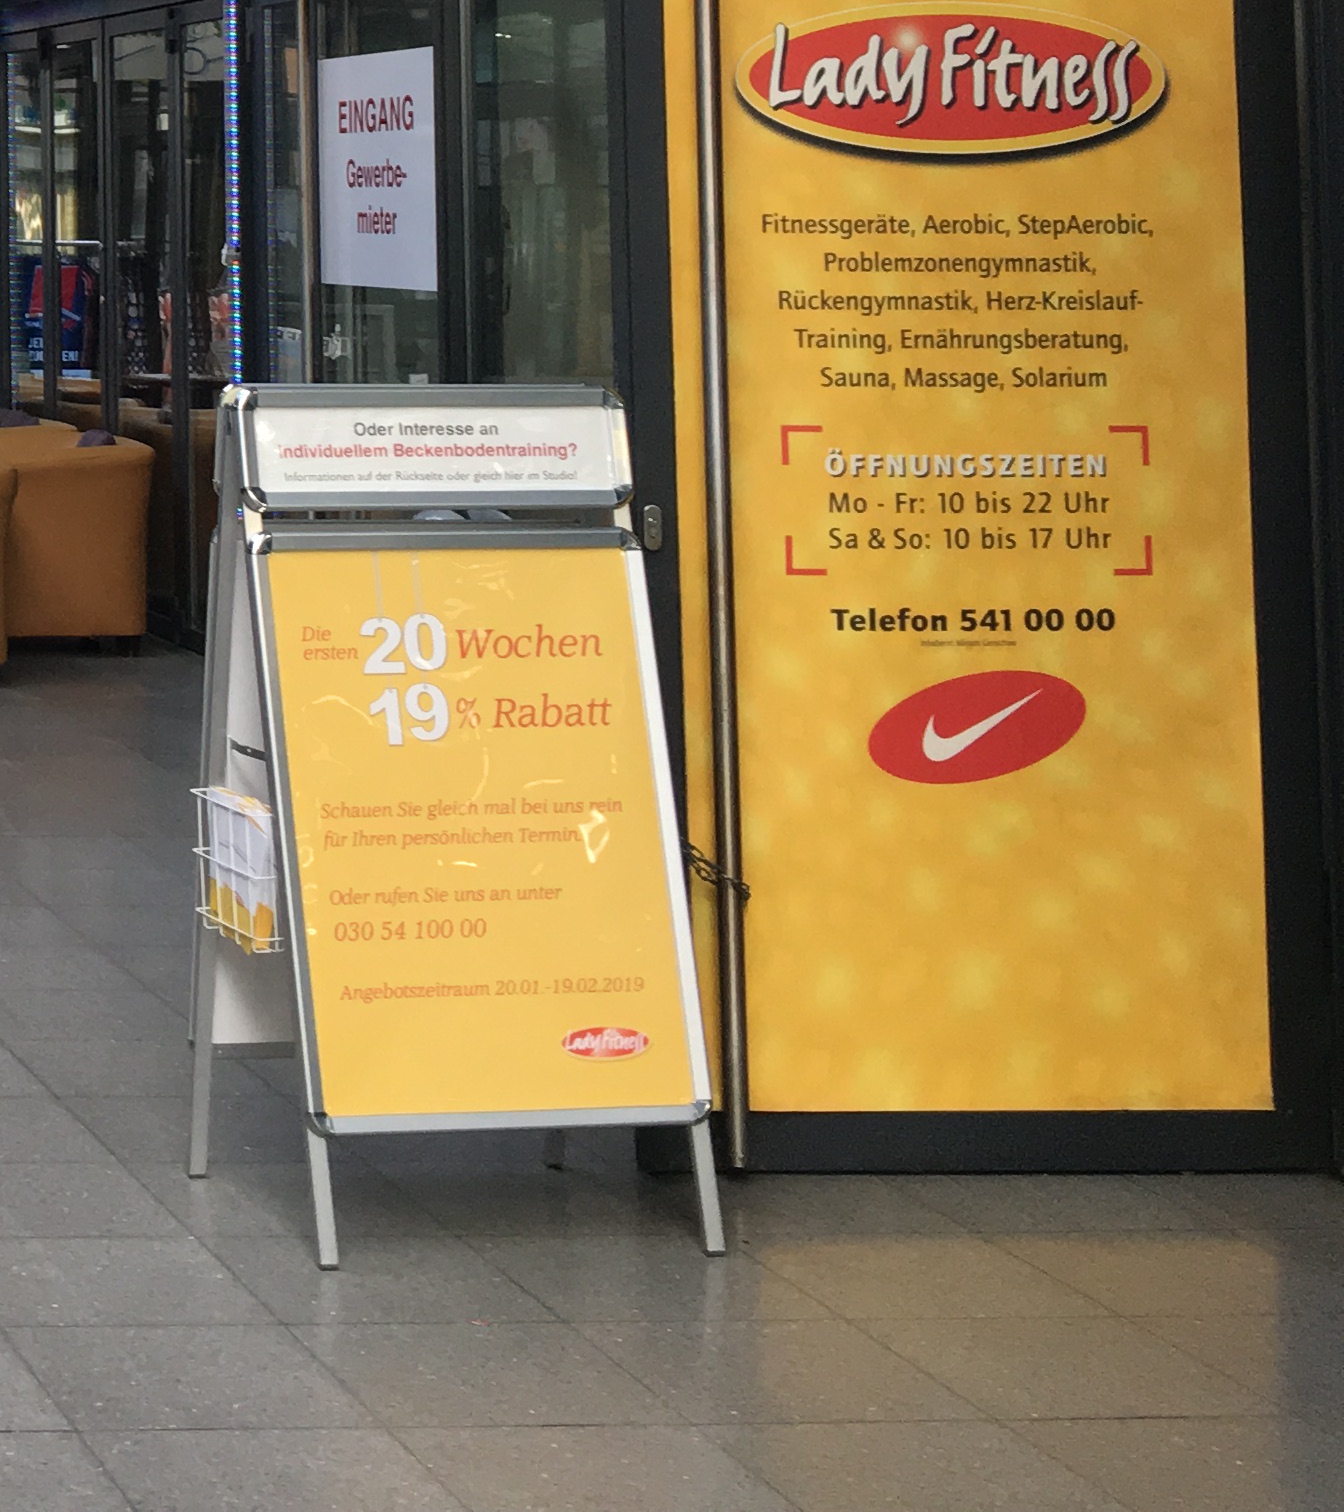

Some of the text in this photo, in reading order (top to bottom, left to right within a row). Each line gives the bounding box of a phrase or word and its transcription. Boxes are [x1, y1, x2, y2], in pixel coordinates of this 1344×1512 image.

[769, 22, 1140, 126] Lady Fitness
[338, 94, 414, 134] EINGANG
[345, 158, 407, 188] Gewerbe-
[356, 204, 397, 235] mieter
[761, 213, 1154, 239] Fitnessgeräte, Aerobic, StepAerobic,
[823, 252, 1097, 278] Problemzonengymnastik,
[778, 290, 1143, 316] Rückengymnastik, Herz-Kreislauf-
[794, 329, 1129, 354] Training, Ernährungsberatung,
[820, 367, 1108, 393] Sauna, Massage, Solarium
[353, 423, 499, 436] Oder Interesse an
[278, 442, 578, 460] individuellem Beckenbodentraining?
[824, 448, 1108, 477] ÖFFNUNGSZEITEN
[284, 472, 355, 483] Informationen
[358, 471, 373, 481] auf
[375, 471, 392, 481] der
[395, 471, 443, 481] Rückseite
[446, 471, 470, 481] oder
[473, 471, 502, 483] gleich
[504, 471, 524, 480] hier
[828, 492, 868, 513] Mo
[895, 492, 925, 513] Fr:
[938, 492, 964, 513] 10
[975, 491, 1012, 513] bis
[1022, 492, 1052, 513] 22
[1064, 491, 1110, 513] Uhr
[828, 527, 1112, 549] Sa & So: 10 bis 17 Uhr
[830, 608, 1116, 632] Telefon 541 00 00
[302, 626, 332, 642] Die
[303, 613, 603, 675] ersten 20 Wochen
[369, 683, 612, 746] 19 % Rabatt
[321, 797, 623, 820] Schauen Sie gleich mal bei uns rein
[323, 830, 348, 851] für
[352, 830, 397, 847] Ihren
[401, 828, 513, 850] persönlichen
[329, 886, 562, 907] Oder rufen Sie uns an unter
[334, 918, 487, 942] 030 54 100 00
[339, 981, 490, 1004] Angebotszeitraum
[565, 1030, 602, 1056] Lady
